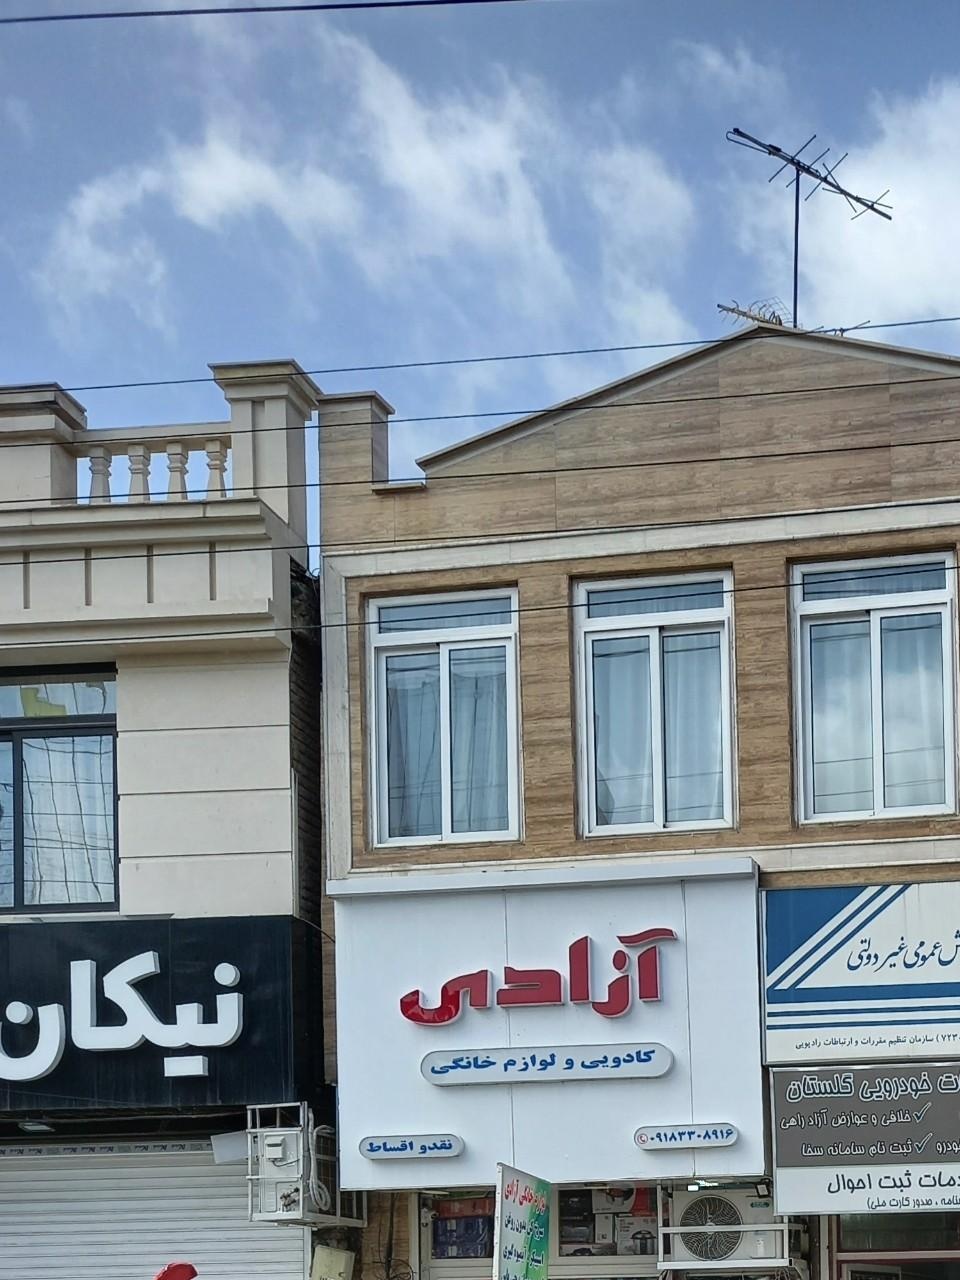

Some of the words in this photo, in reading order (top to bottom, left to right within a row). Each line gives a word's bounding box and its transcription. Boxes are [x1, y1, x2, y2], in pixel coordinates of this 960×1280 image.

[847, 938, 879, 971] دولتی
[874, 936, 908, 973] غیر
[903, 940, 942, 969] عمومی
[400, 927, 678, 1026] آزادی
[0, 951, 244, 1082] نیکان
[823, 1037, 853, 1048] ارتباطات
[860, 1036, 886, 1047] مقررات
[888, 1035, 907, 1048] تنظیم
[909, 1034, 934, 1045] سازمان
[430, 1054, 497, 1076] خانگی
[503, 1052, 557, 1073] لوازم
[564, 1057, 575, 1070] و
[580, 1048, 656, 1070] کادویی
[859, 1072, 932, 1101] خودرویی
[780, 1112, 805, 1129] راهی
[807, 1108, 829, 1128] آزاد
[831, 1112, 868, 1127] عوارض
[871, 1114, 878, 1126] و
[881, 1110, 912, 1127] خلافی
[649, 1127, 734, 1143] ۰۹۱۸۳۳۰۸۹۱۶
[366, 1140, 414, 1154] اقساط
[802, 1143, 824, 1157] سخا
[827, 1142, 865, 1157] سامانه
[869, 1141, 886, 1157] نام
[889, 1138, 912, 1157] ثبت
[827, 1173, 872, 1194] احوال
[877, 1169, 912, 1193] ثبت
[504, 1178, 519, 1203] آزادی
[889, 1195, 910, 1208] کارت
[912, 1197, 933, 1209] صدور
